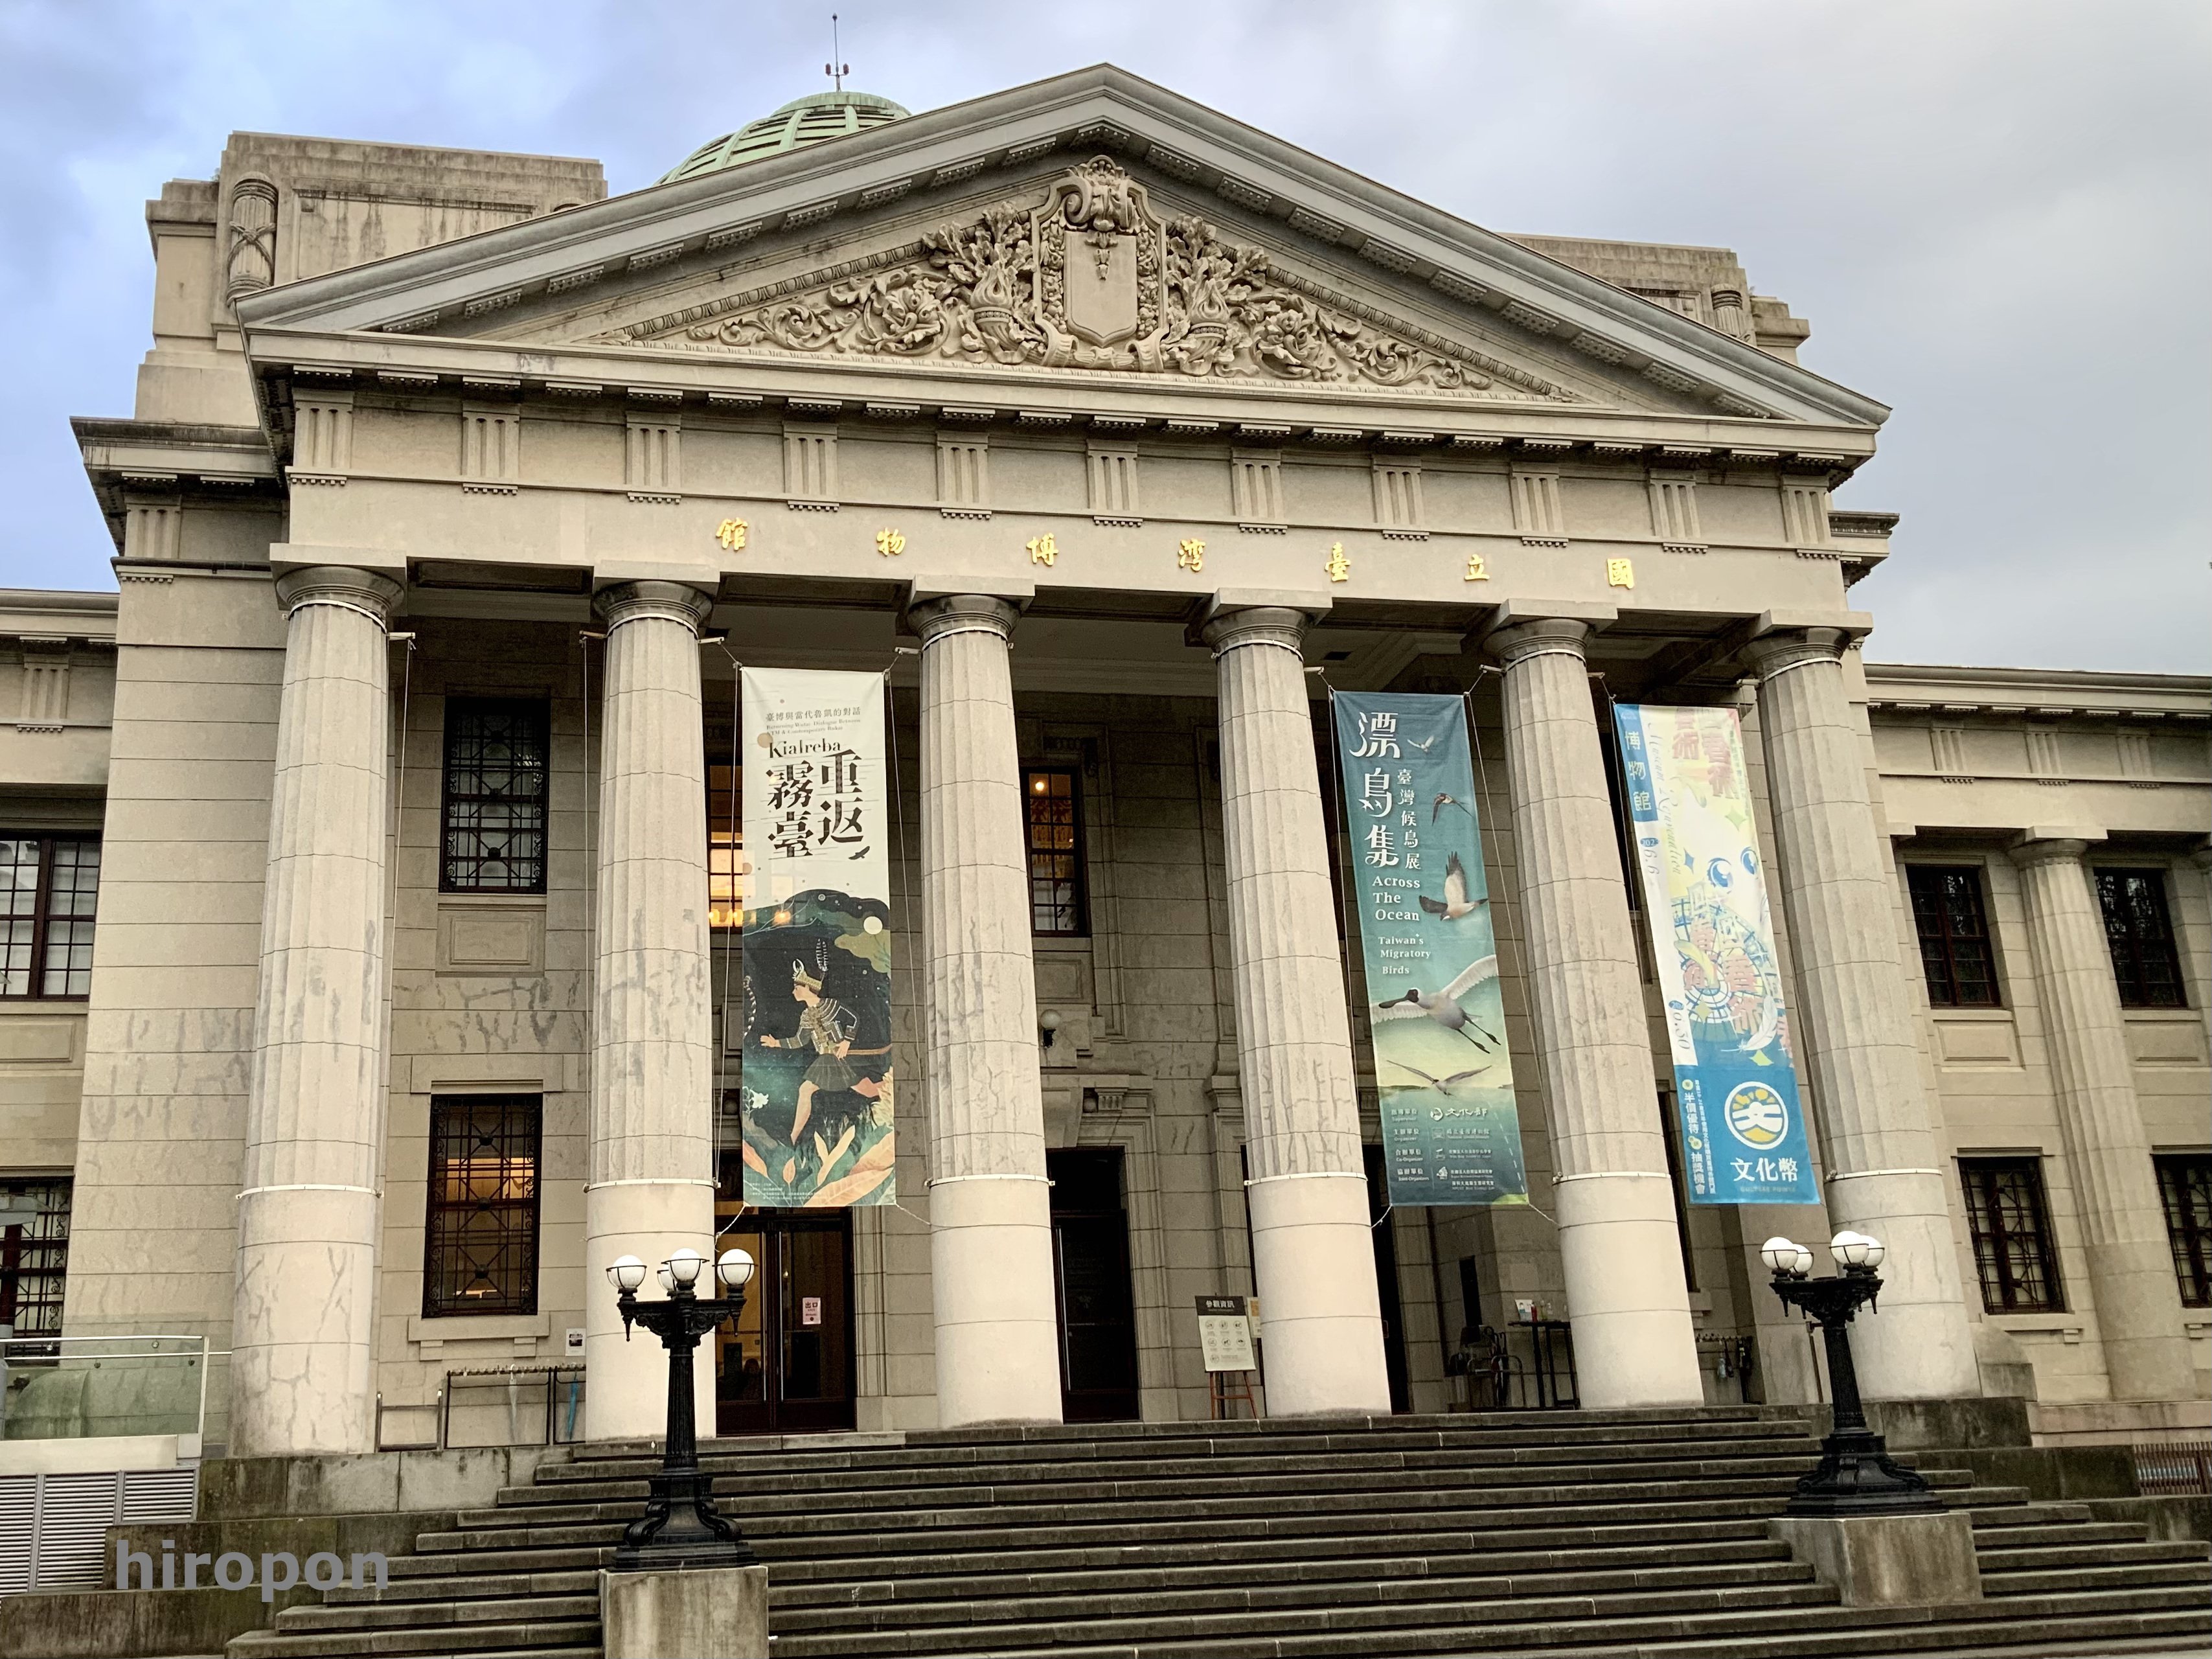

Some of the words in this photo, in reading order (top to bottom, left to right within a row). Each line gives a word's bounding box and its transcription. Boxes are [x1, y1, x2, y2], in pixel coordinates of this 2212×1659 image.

[1625, 731, 1652, 812] 博物館
[817, 749, 863, 845] 重返
[1349, 711, 1400, 869] 漂鳥集
[1397, 768, 1422, 870] 臺灣候鳥展
[1372, 875, 1420, 889] Across
[1373, 892, 1401, 904] The
[1375, 909, 1420, 922] Ocean
[1380, 949, 1432, 960] Migratory
[1382, 965, 1410, 975] Birds
[1729, 1157, 1798, 1182] 文化幣
